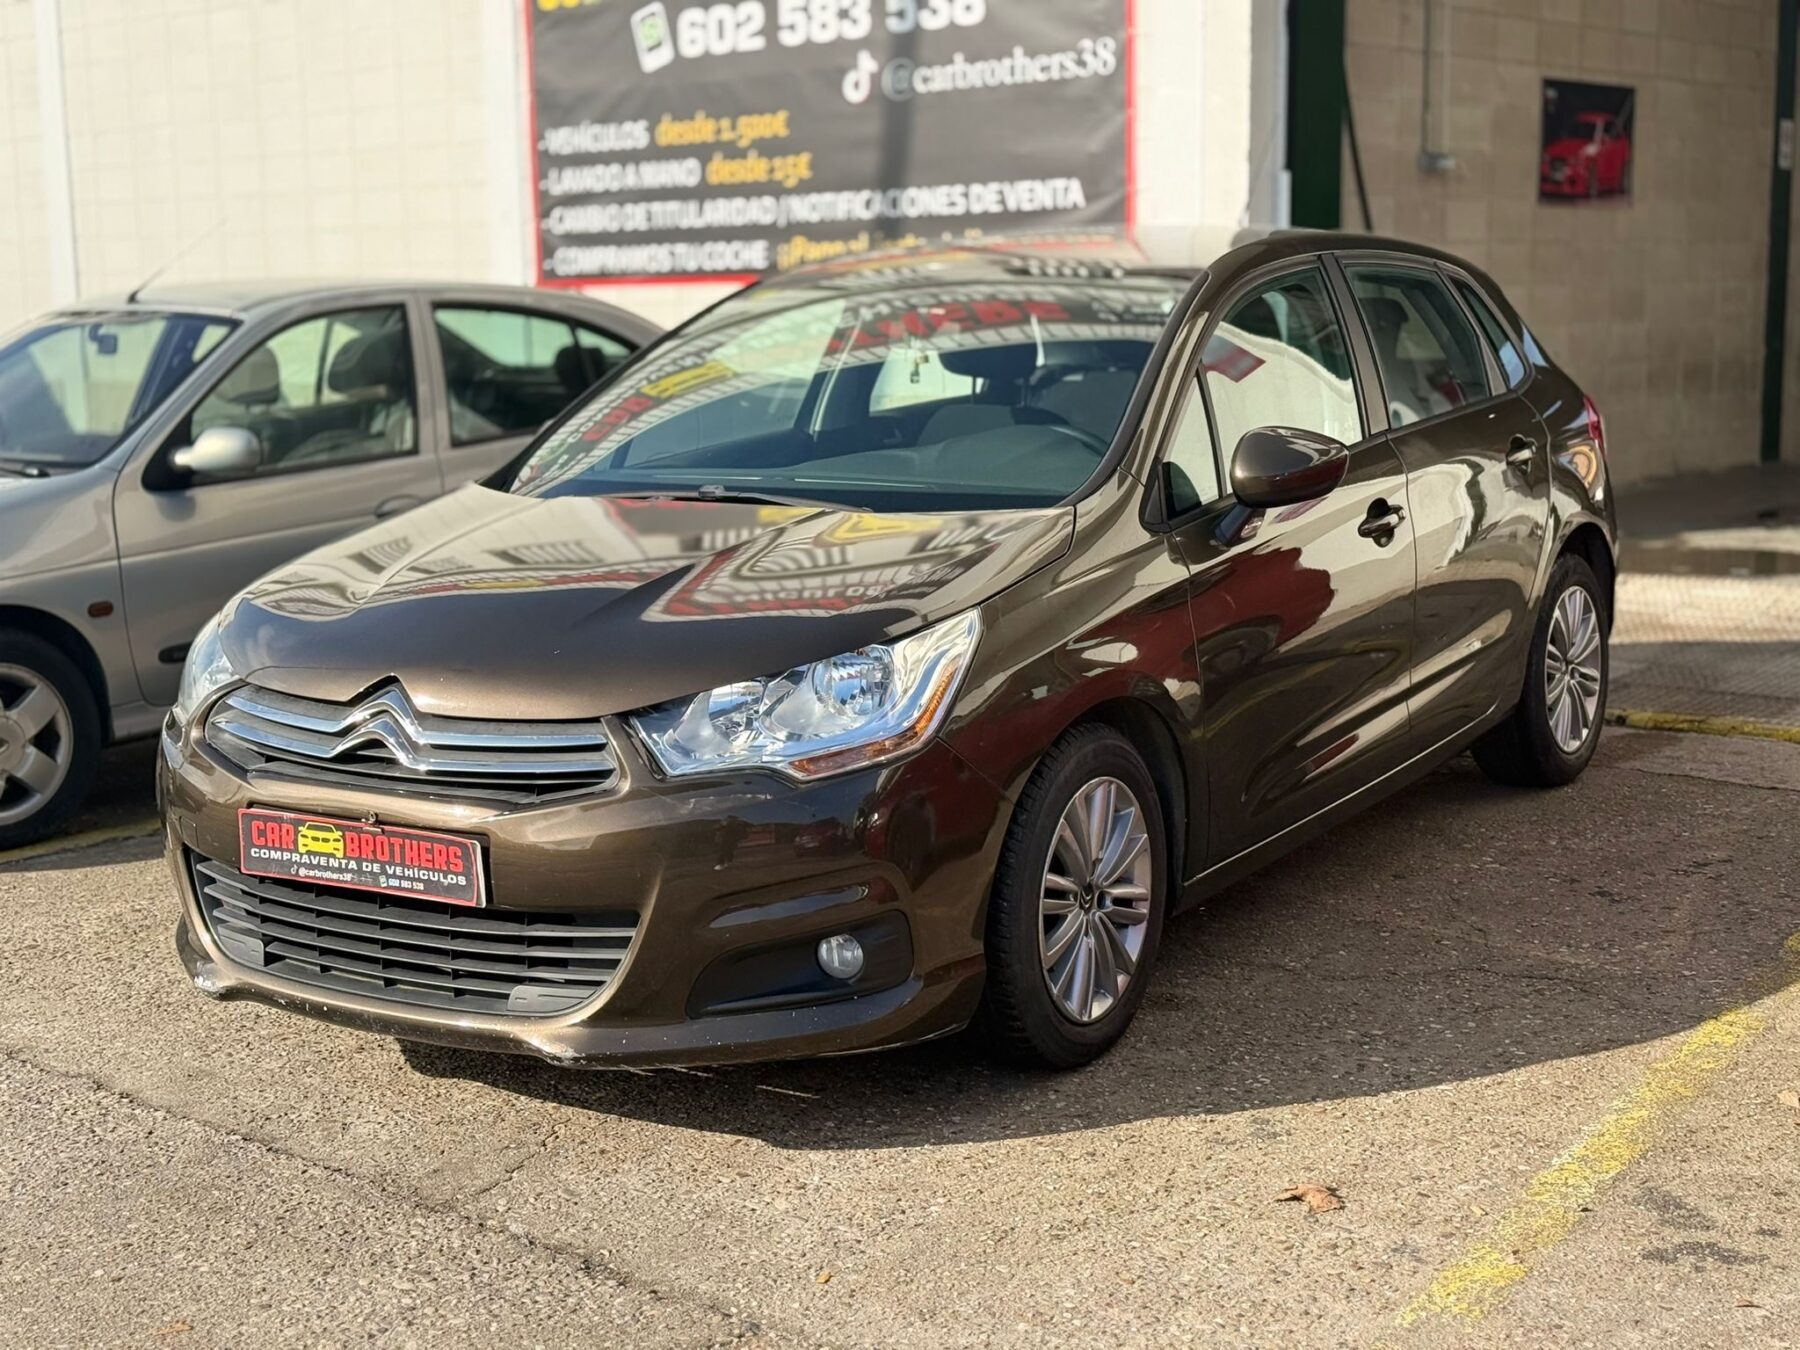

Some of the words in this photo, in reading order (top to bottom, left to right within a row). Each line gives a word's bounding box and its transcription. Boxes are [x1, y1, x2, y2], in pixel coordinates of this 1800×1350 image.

[676, 0, 767, 58] 602
[777, 0, 872, 47] 583
[250, 848, 358, 870] COMPRAVENTA
[362, 861, 381, 873] DE
[385, 865, 467, 886] VEHÍCULOS
[251, 820, 294, 849] CAR
[345, 831, 464, 873] BROTHERS
